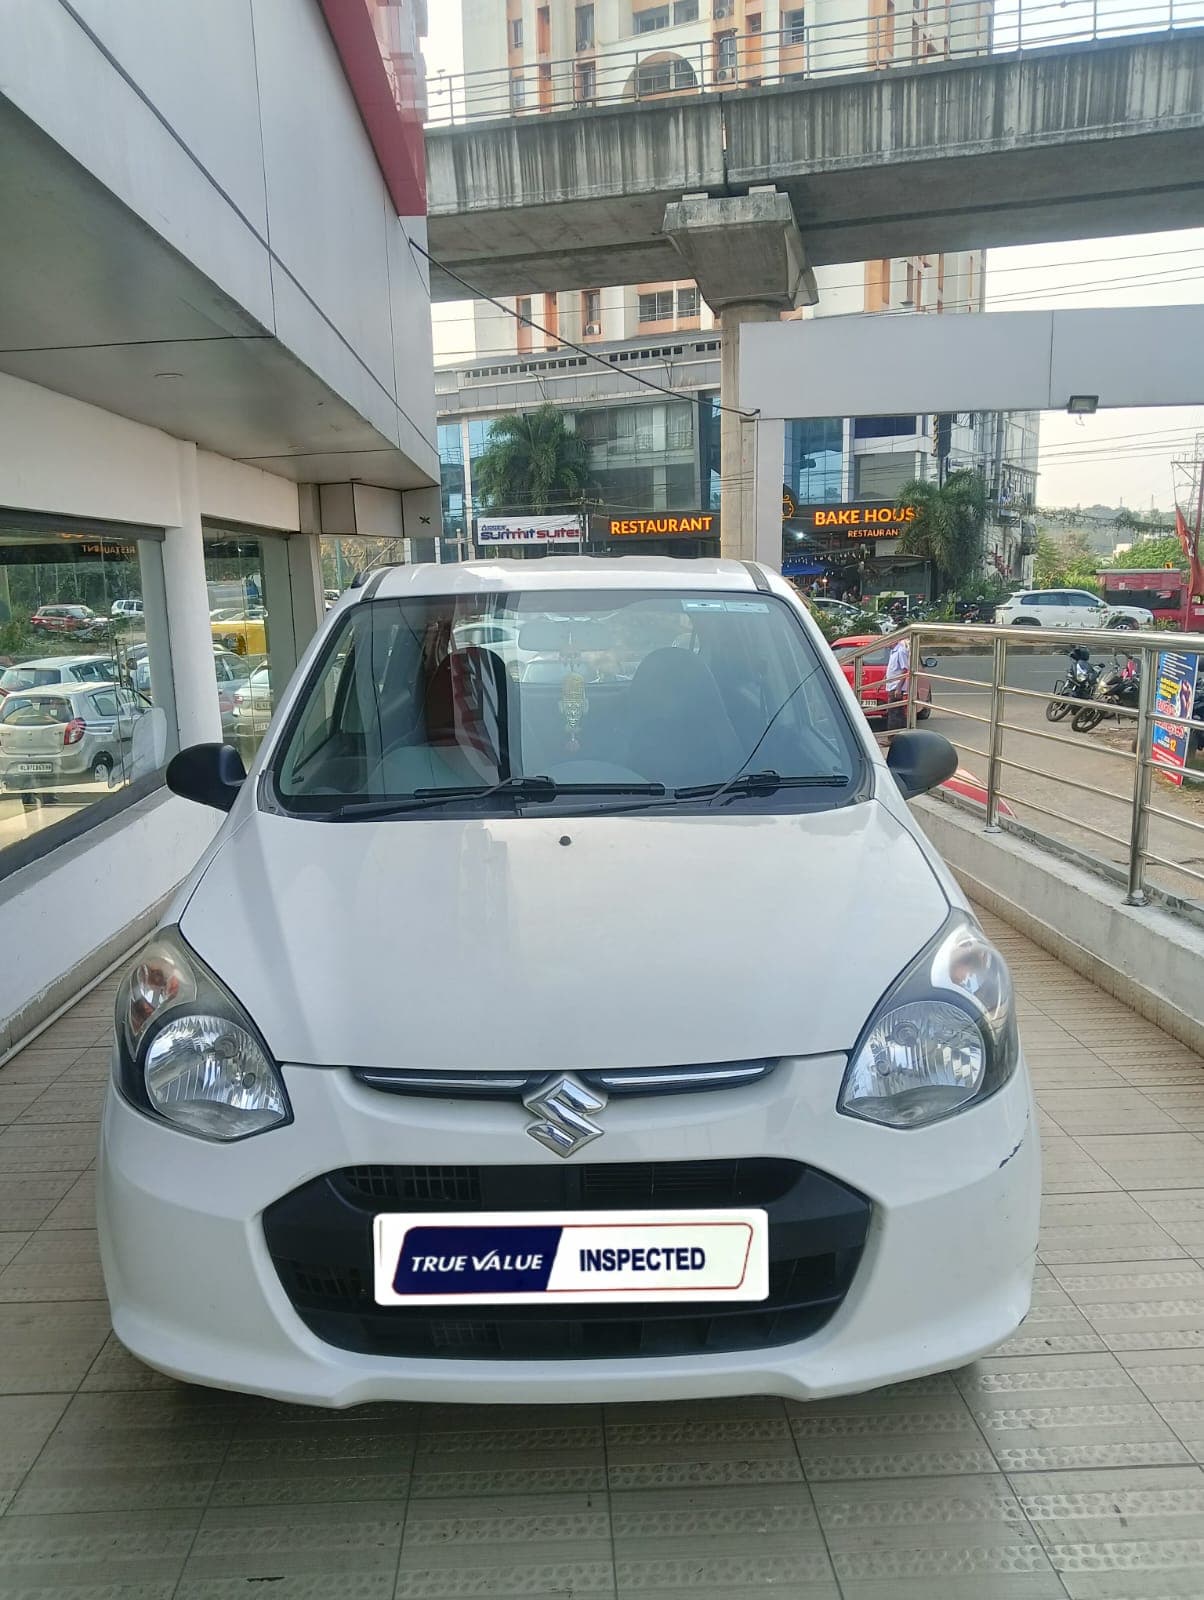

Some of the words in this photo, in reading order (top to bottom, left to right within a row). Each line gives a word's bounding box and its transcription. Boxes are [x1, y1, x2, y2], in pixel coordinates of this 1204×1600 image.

[610, 516, 713, 535] RESTAURANT
[815, 509, 860, 526] BAKE
[864, 506, 920, 523] HOUS
[847, 528, 900, 538] RESTAURAN
